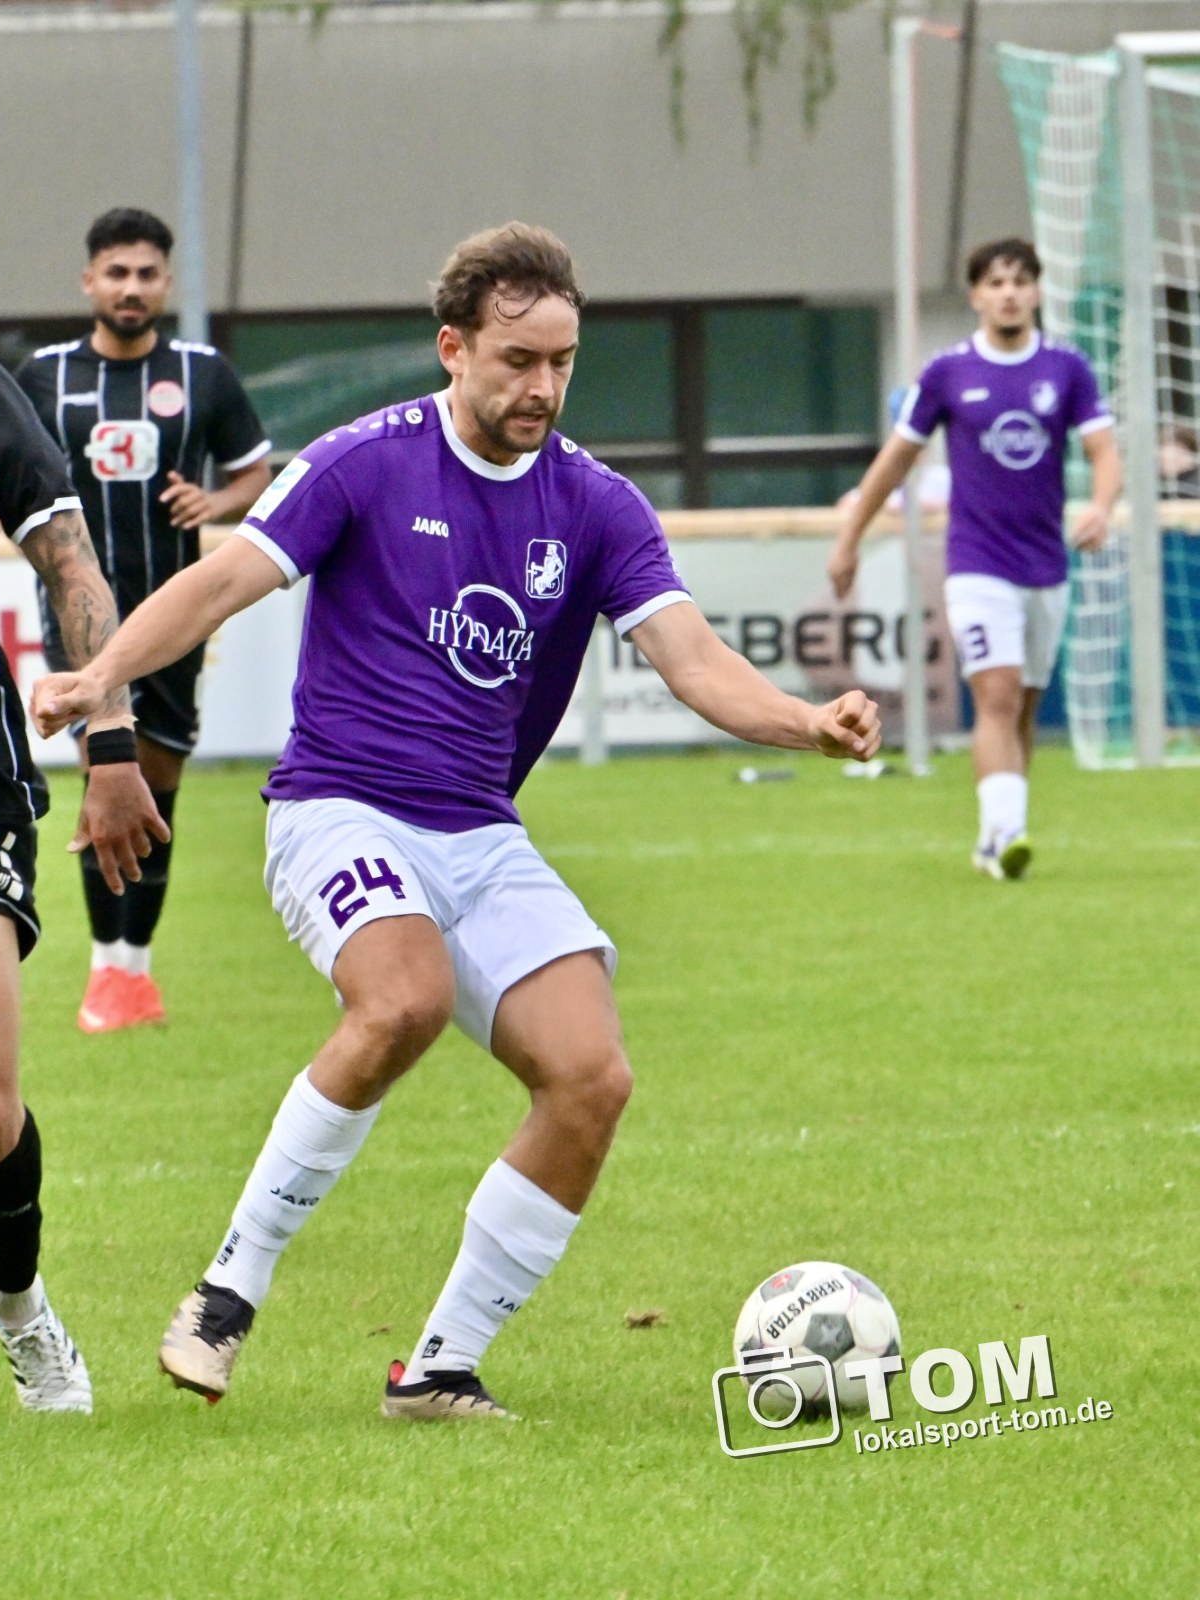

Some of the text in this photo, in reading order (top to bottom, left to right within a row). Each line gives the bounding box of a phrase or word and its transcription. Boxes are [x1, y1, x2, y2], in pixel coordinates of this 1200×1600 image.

[412, 516, 450, 538] JAKO
[318, 856, 407, 931] 24
[766, 1279, 845, 1340] DERBYSTAR
